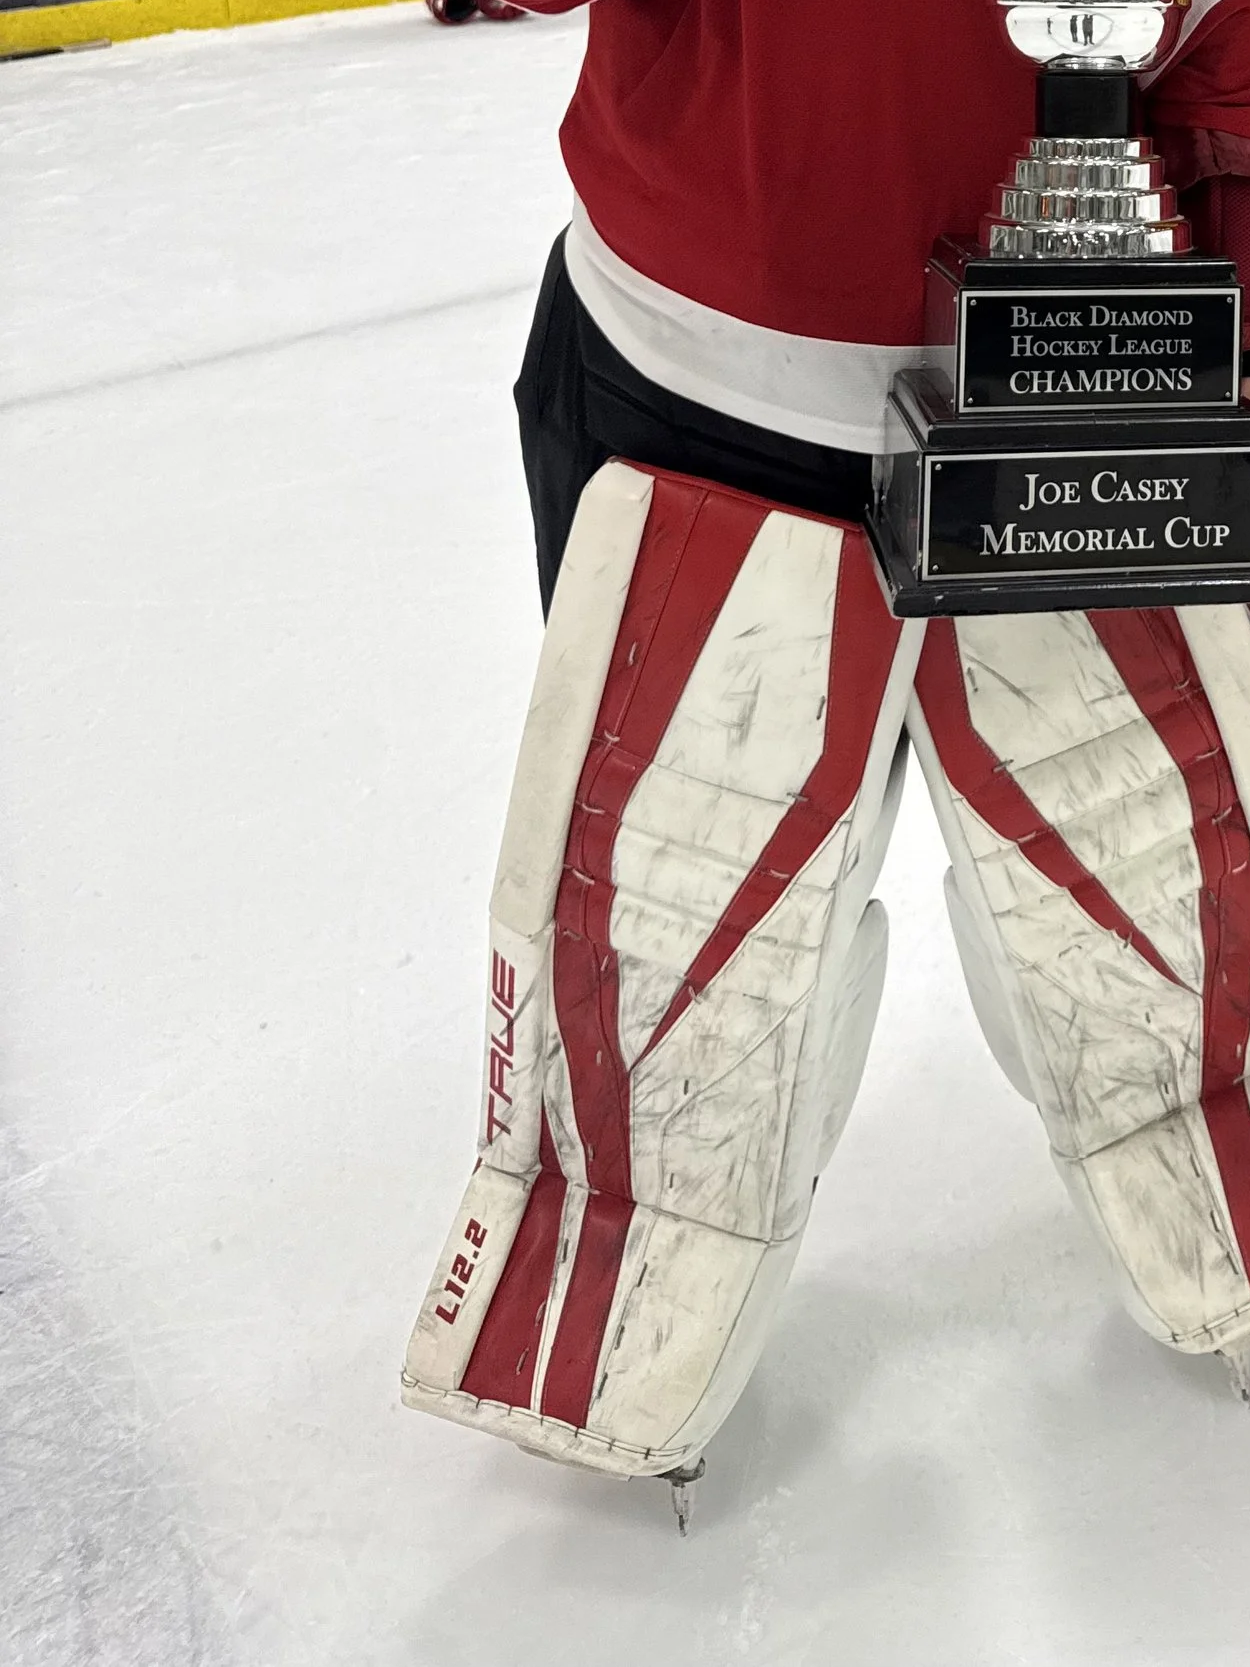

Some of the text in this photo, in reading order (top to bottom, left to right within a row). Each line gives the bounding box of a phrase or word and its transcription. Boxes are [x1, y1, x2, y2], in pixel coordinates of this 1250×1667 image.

[1009, 367, 1194, 395] CHAMPIONS
[486, 947, 516, 1146] TRUE
[434, 1217, 489, 1326] L12.2
